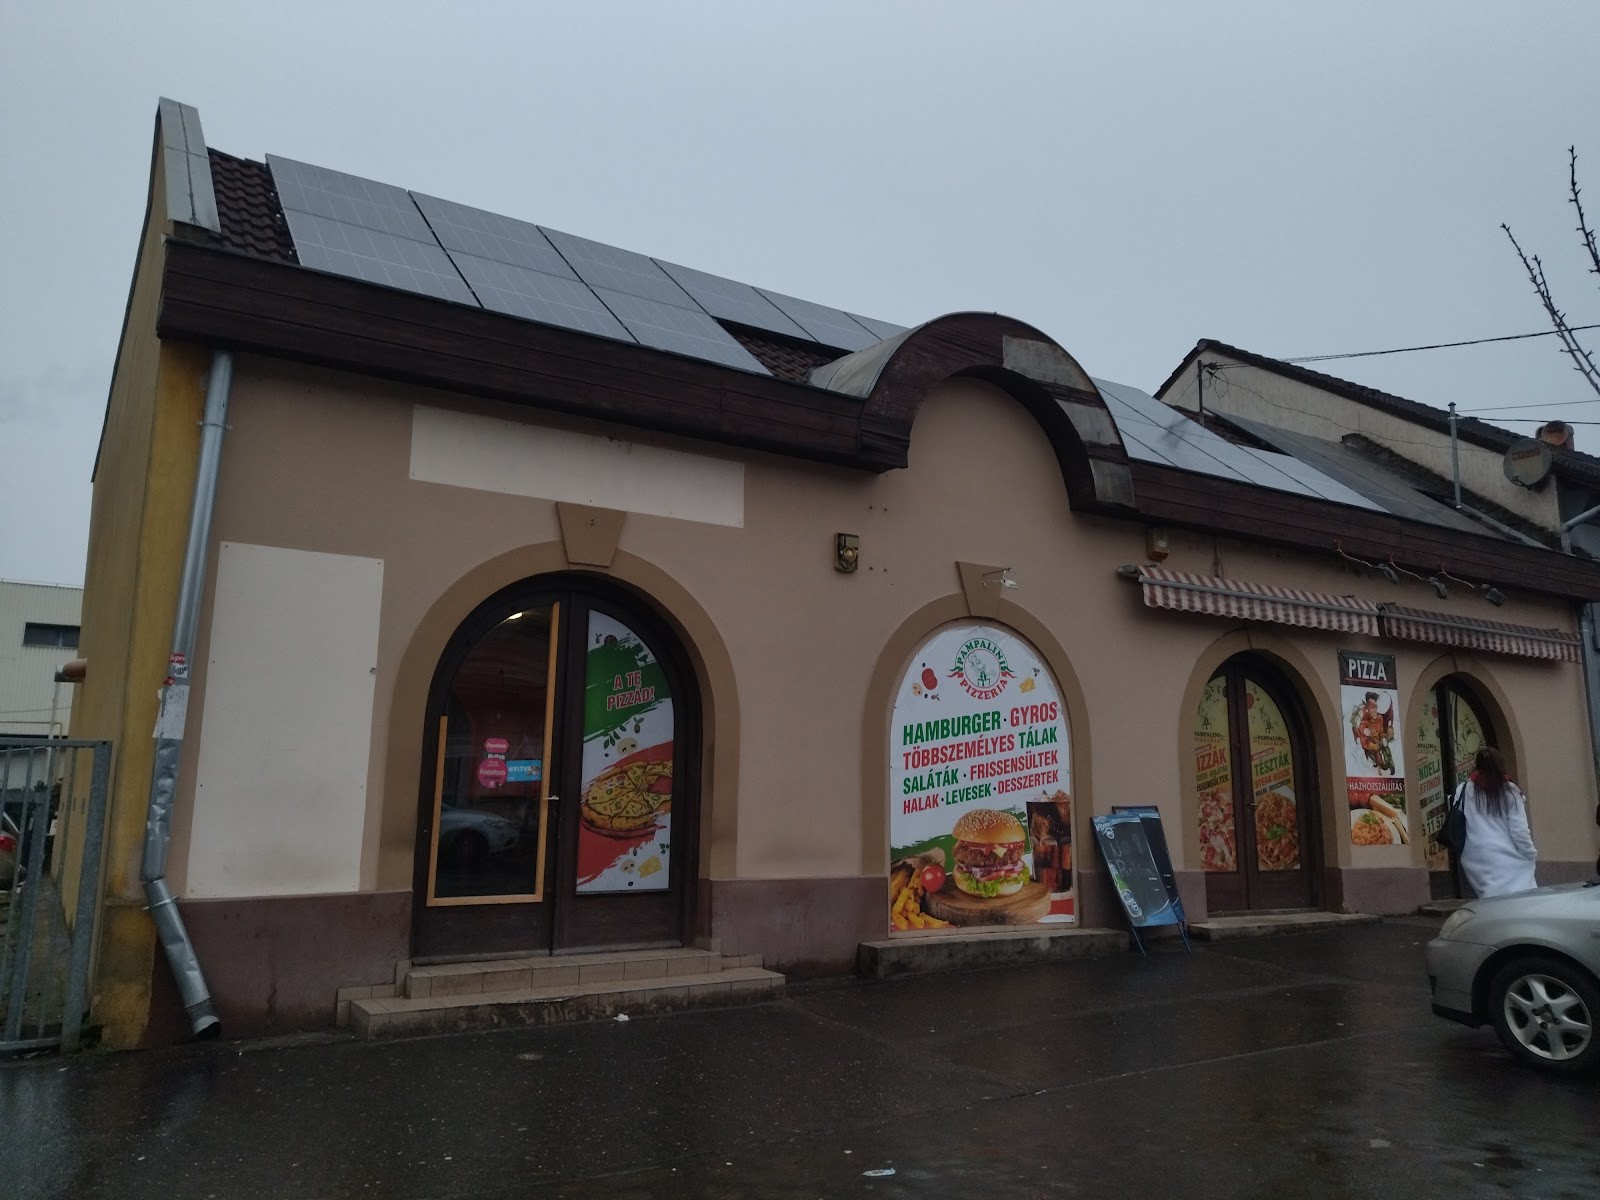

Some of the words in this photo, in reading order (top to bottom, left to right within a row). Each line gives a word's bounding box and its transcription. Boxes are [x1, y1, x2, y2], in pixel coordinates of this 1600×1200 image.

[957, 640, 1006, 665] PAMPALINI
[613, 674, 624, 691] A
[626, 670, 642, 687] TE
[1348, 659, 1387, 681] PIZZA
[606, 685, 655, 711] PIZZÁD!
[959, 678, 1008, 700] PIZZERIA
[903, 710, 1001, 746] HAMBURGER
[1010, 701, 1058, 728] GYROS
[903, 733, 1015, 770] TÖBBSZEMÉLYES
[1018, 726, 1058, 749] TÁLAK
[1197, 745, 1227, 772] IZZÁK
[479, 768, 506, 776] foodora
[508, 765, 532, 773] NYITVA
[903, 766, 959, 795] SALÁTÁK
[970, 750, 1058, 781] FRISSENSÜLTEK
[1254, 751, 1289, 776] TÉSZTÁK
[1418, 759, 1440, 781] NDELJ
[903, 793, 939, 815] HALAK
[945, 783, 991, 806] LEVESEK
[997, 769, 1059, 795] DESSZERTEK
[1197, 774, 1229, 792] ISSENSÜLTEK
[1349, 780, 1403, 792] HÁZHOZSZÁLLÍTÁS
